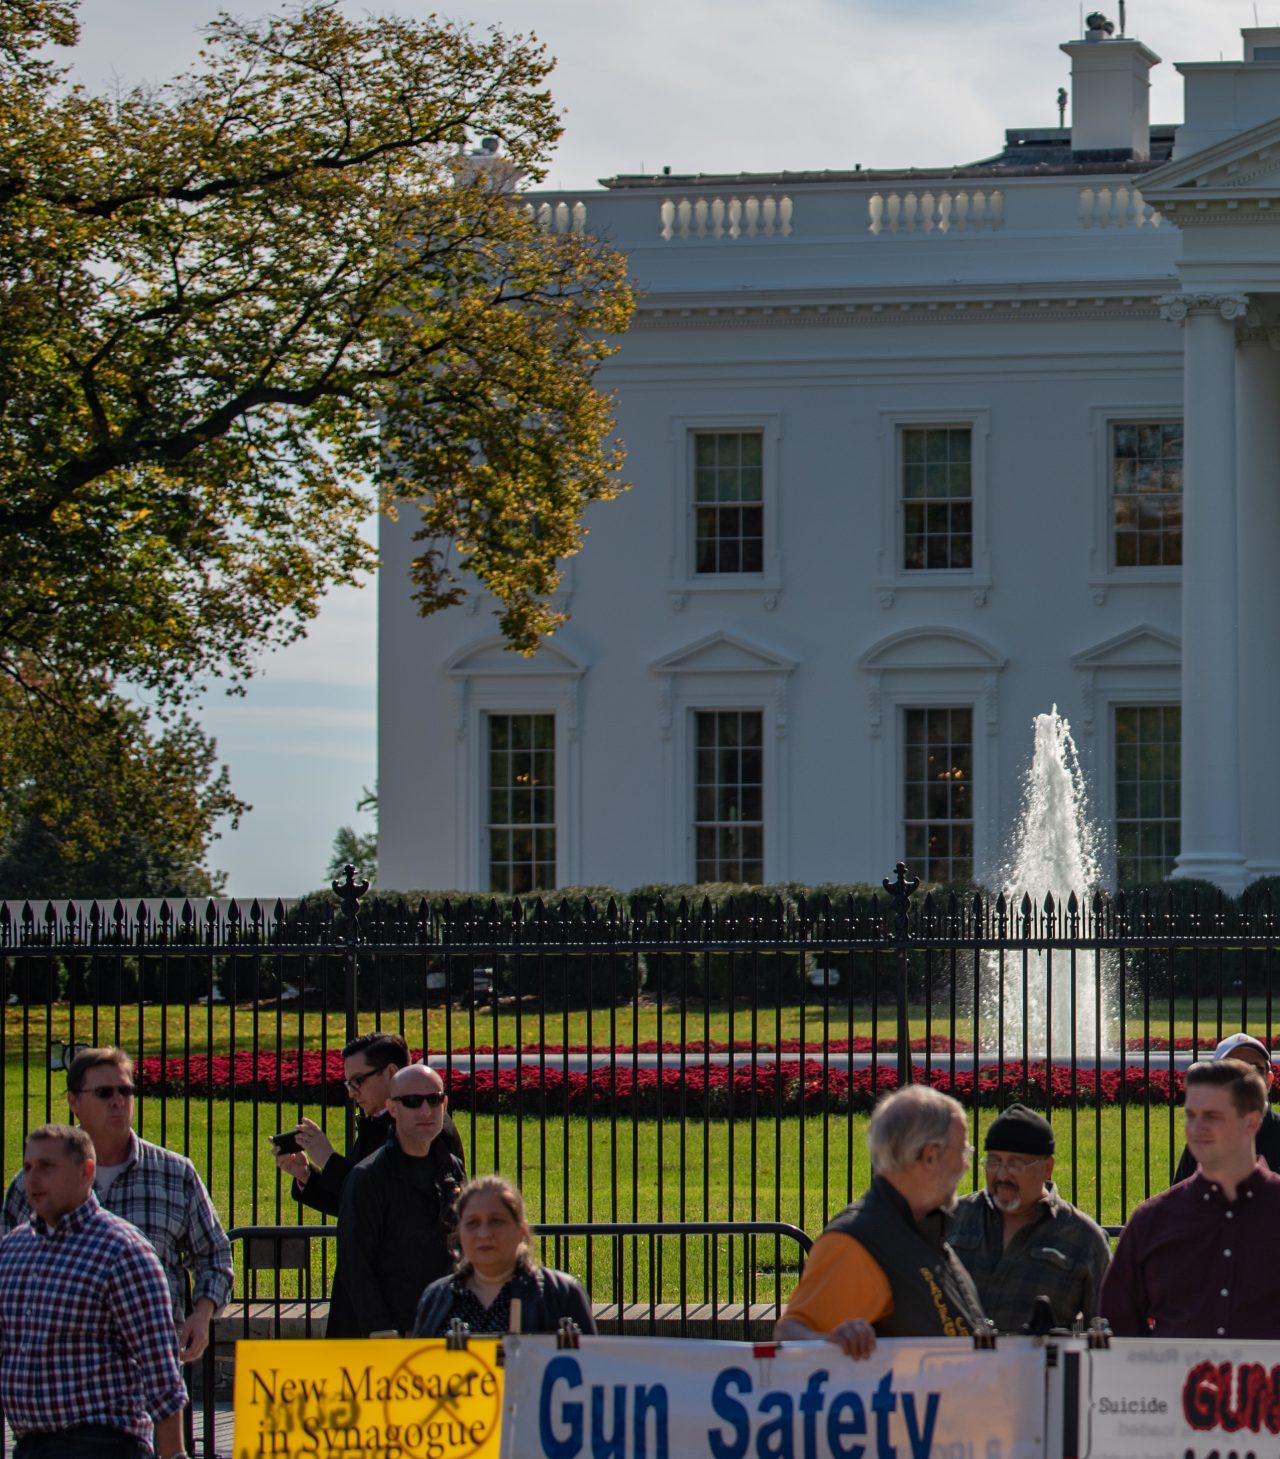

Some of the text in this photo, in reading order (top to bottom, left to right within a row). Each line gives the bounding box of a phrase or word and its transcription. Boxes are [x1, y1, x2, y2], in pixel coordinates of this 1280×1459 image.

[249, 1365, 497, 1405] New Massacre
[1098, 1396, 1169, 1415] Suicide
[539, 1355, 941, 1459] Gun Safety
[258, 1416, 486, 1459] in Synagogue
